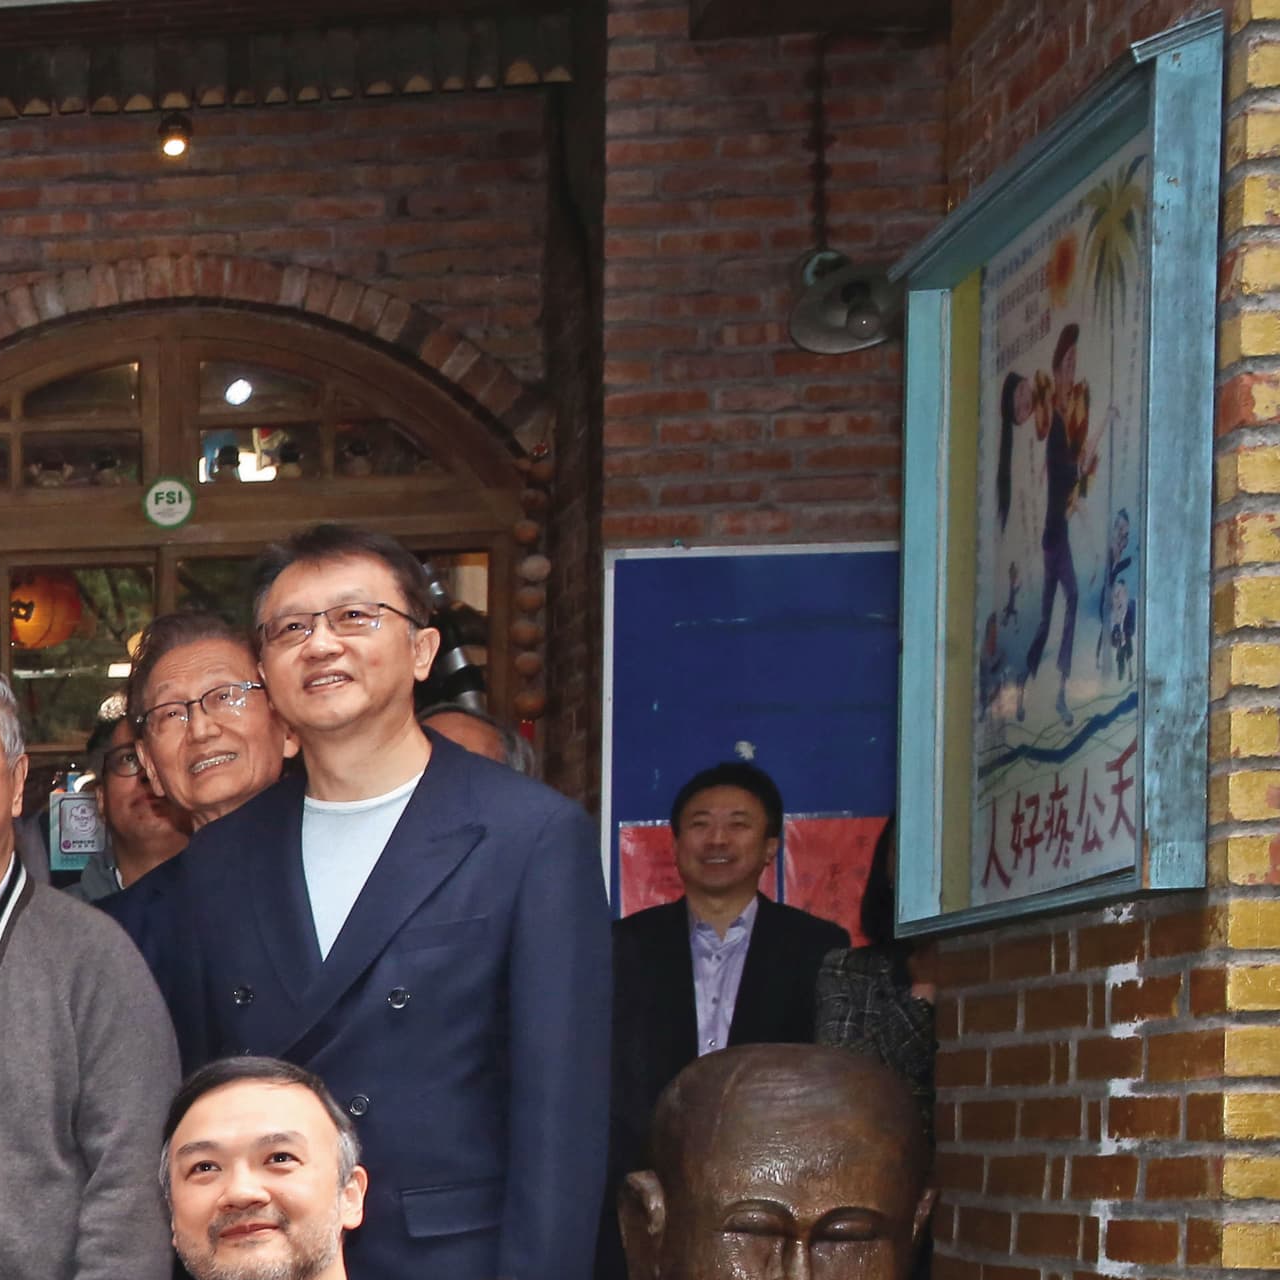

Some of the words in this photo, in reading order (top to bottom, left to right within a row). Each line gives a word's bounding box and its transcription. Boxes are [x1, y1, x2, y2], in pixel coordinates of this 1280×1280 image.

[155, 491, 182, 505] FSI
[981, 736, 1138, 889] 天公疼好人
